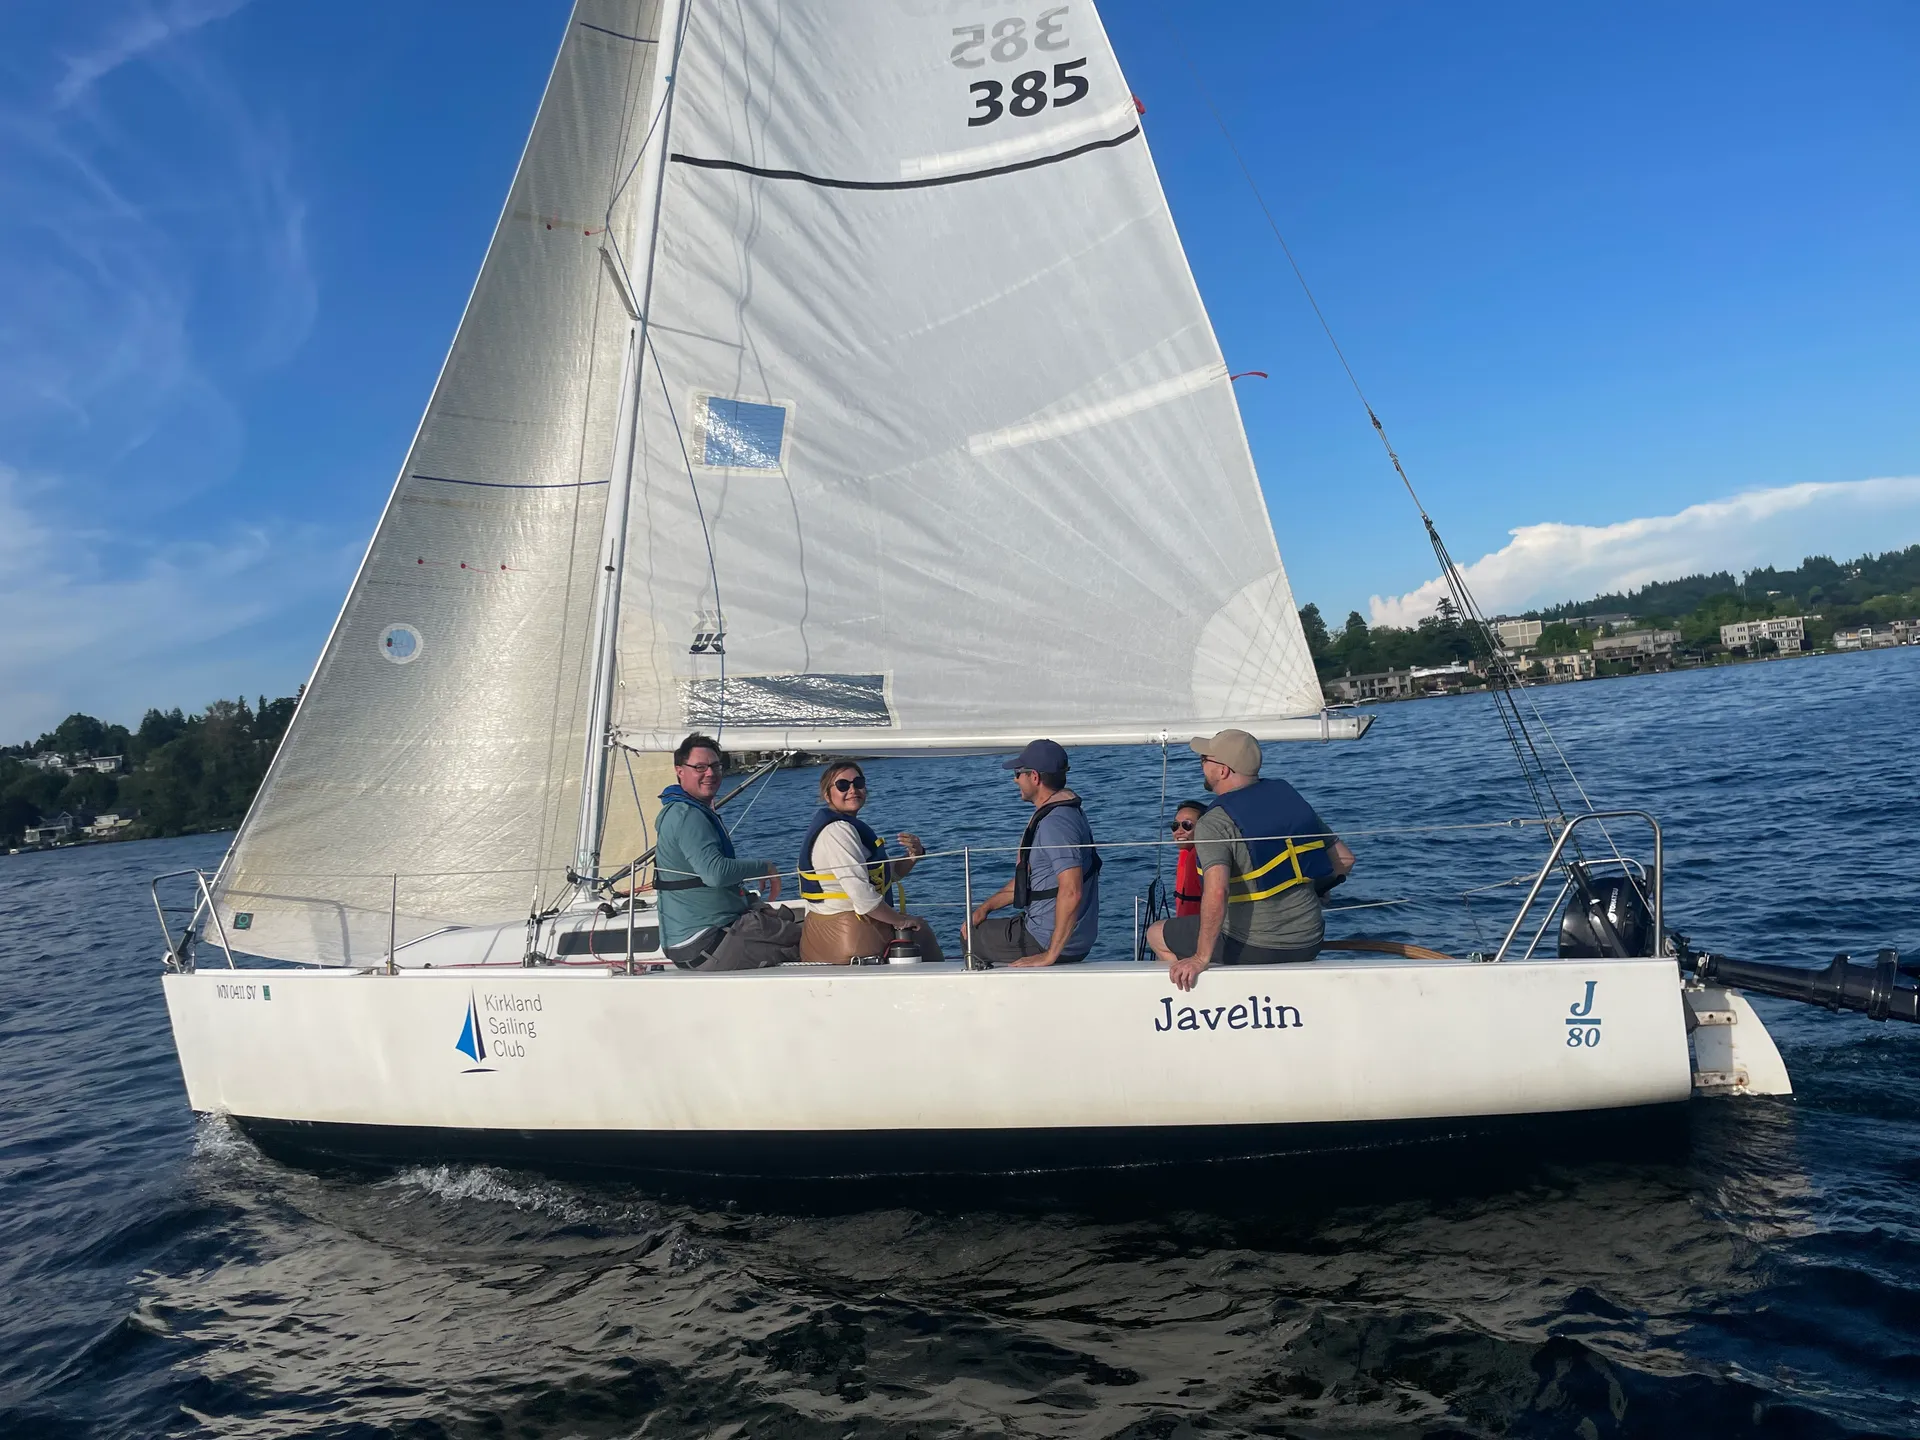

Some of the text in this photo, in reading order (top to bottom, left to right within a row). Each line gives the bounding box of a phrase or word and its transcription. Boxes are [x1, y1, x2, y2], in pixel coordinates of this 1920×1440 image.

[967, 57, 1089, 127] 385
[690, 633, 727, 652] UK
[1608, 888, 1620, 913] TOHATSU
[216, 984, 229, 999] WN
[246, 985, 256, 1000] SV
[484, 993, 542, 1012] Kirkland
[1570, 980, 1598, 1017] J
[1154, 996, 1303, 1032] Javelin
[488, 1016, 537, 1039] Sailing
[1566, 1027, 1601, 1048] 80
[493, 1039, 525, 1058] Club
